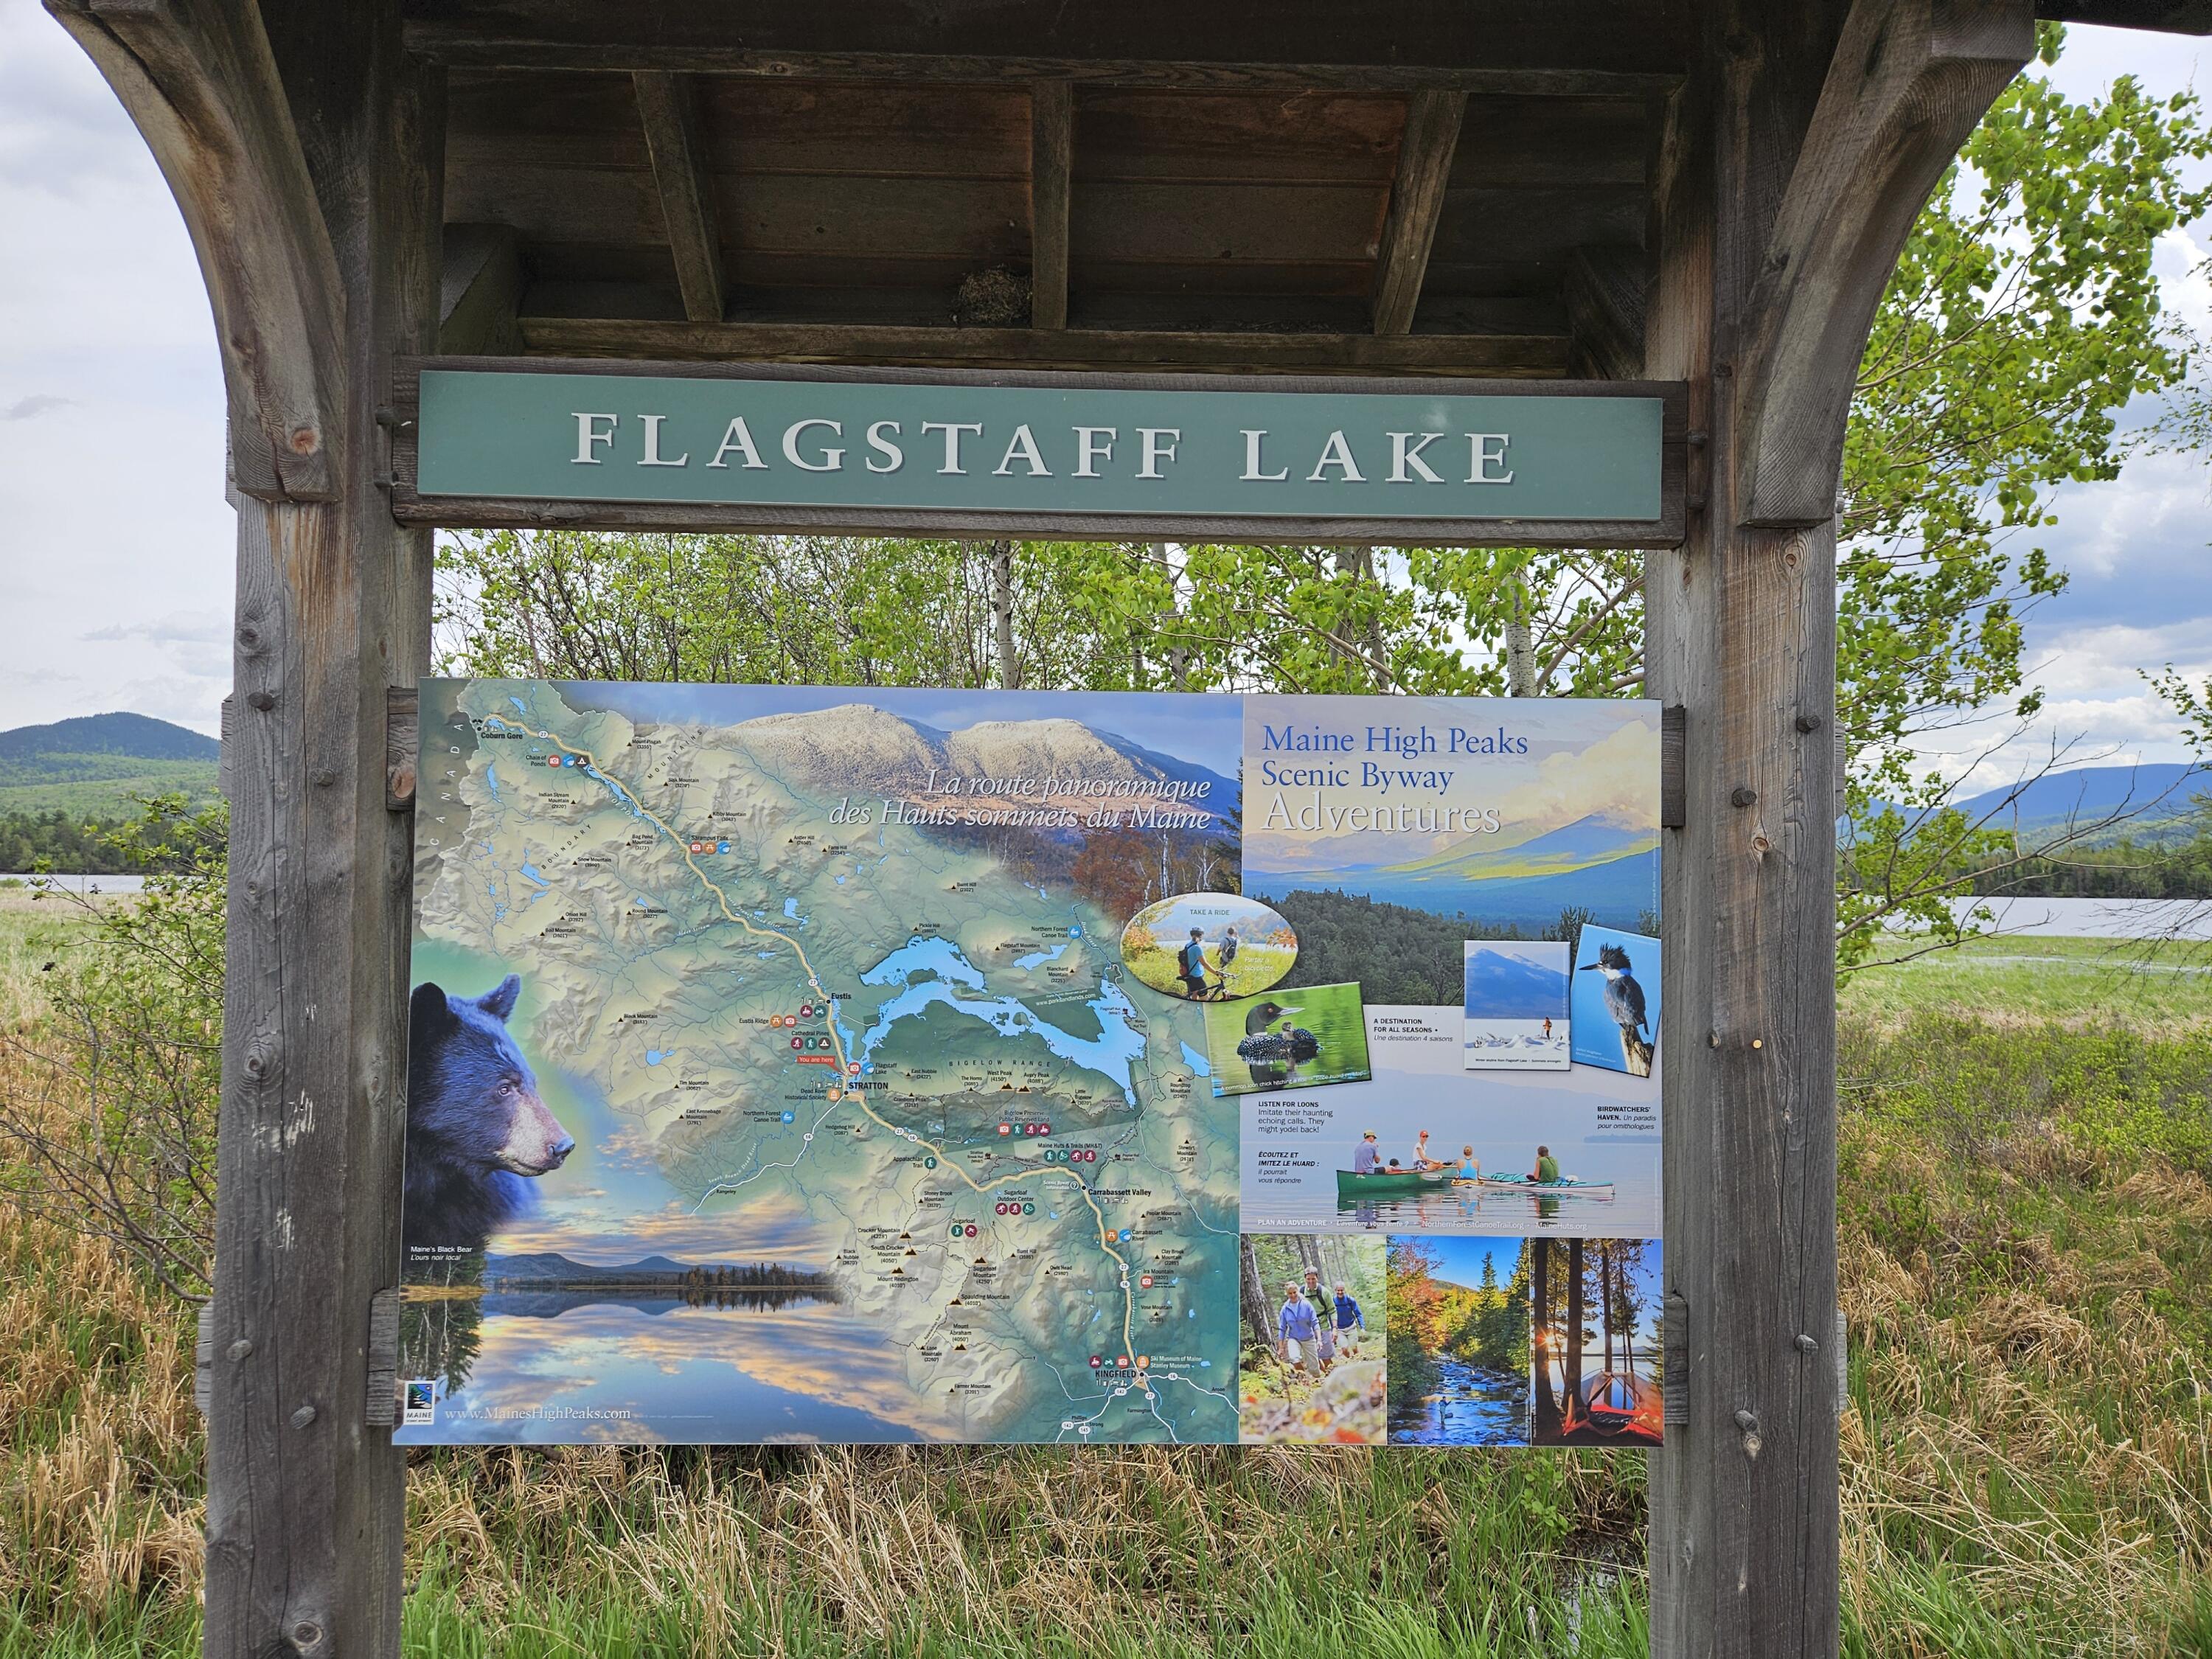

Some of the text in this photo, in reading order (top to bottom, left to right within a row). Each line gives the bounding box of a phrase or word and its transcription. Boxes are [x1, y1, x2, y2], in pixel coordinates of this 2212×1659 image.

[571, 413, 1515, 484] FLAGSTAFF LAKE
[1262, 725, 1528, 759] Maine High Peaks
[1262, 760, 1455, 795] Scenic Byway
[430, 723, 464, 846] CANADA
[925, 768, 1211, 803] La route panoramique
[542, 729, 703, 869] BOUNDARY MOUNTAINS
[829, 798, 1211, 830] des Hauts sommets du Maine
[1260, 790, 1501, 833] Adventures
[1036, 993, 1096, 1006] www.parksandlands.com
[1303, 1109, 1333, 1117] haunting
[1633, 1115, 1657, 1123] paradis
[1309, 1118, 1324, 1126] They
[1613, 1123, 1654, 1131] ornithologues
[1259, 1150, 1288, 1158] ÉCOUTEZ
[1274, 1177, 1301, 1185] répondre
[1132, 1189, 1151, 1197] Valley
[1422, 1220, 1524, 1231] NorthernForestCanoeTrail.org
[1535, 1222, 1587, 1232] MaineHuts.org
[1096, 1370, 1136, 1378] KINGFIELD
[445, 1407, 630, 1422] www.MainesHighPeaks.com
